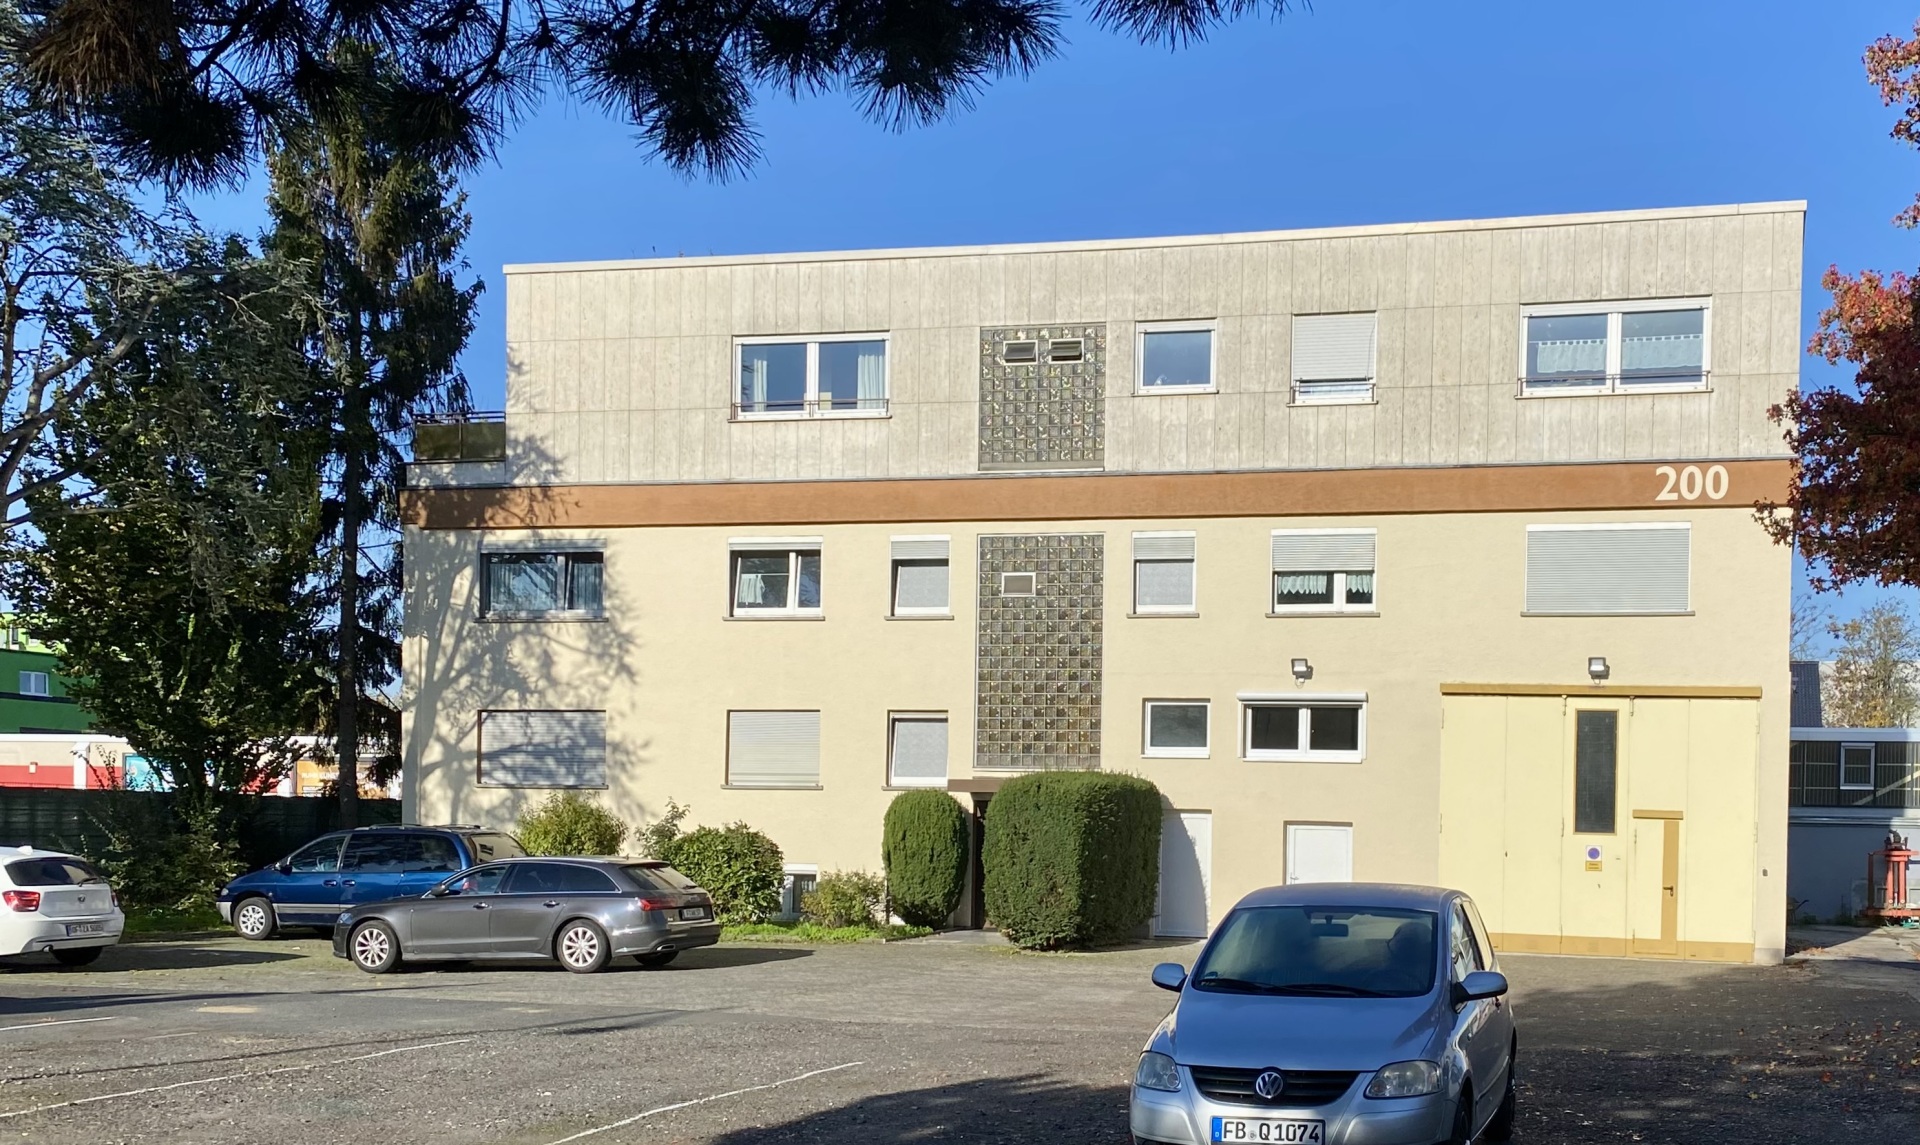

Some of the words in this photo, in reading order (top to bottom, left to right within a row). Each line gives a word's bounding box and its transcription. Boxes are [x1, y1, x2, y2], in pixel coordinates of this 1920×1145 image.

[1655, 465, 1729, 501] 200
[1256, 1072, 1283, 1098] VW
[1223, 1121, 1246, 1140] FB
[1274, 1123, 1320, 1143] 1074
